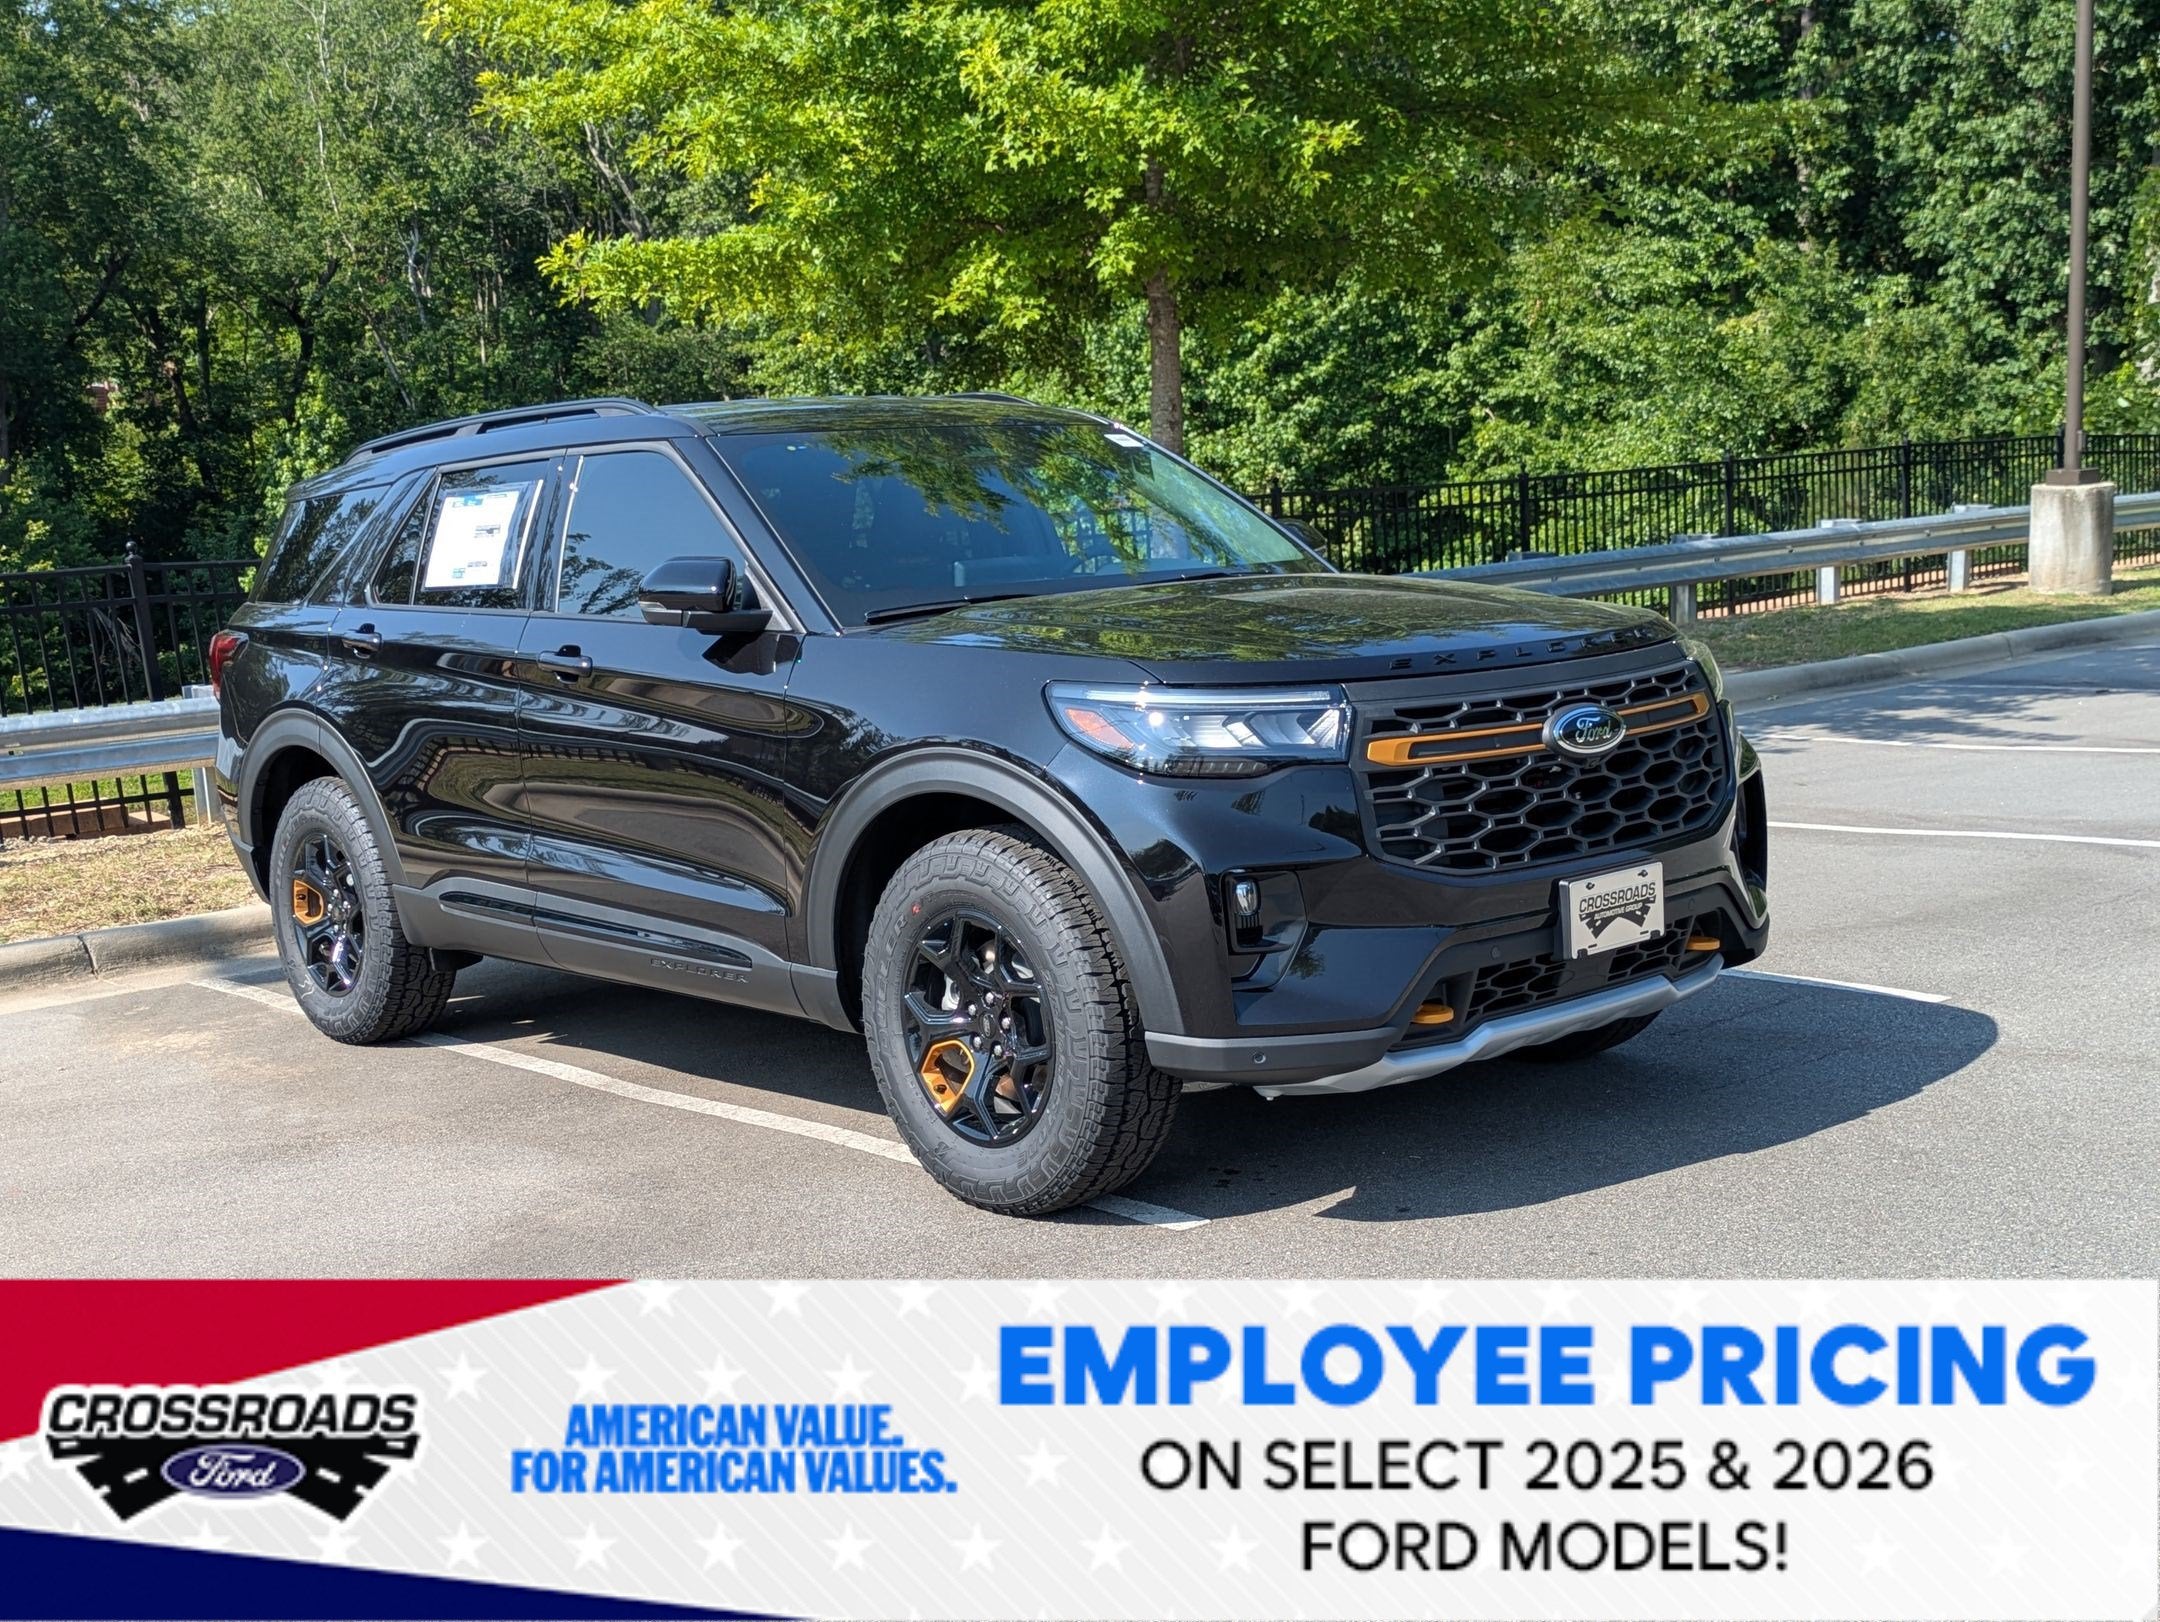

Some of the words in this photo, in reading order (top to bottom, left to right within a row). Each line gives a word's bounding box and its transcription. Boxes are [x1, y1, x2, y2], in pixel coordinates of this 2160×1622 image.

[1575, 716, 1613, 743] Ford
[1579, 882, 1656, 913] CROSSROADS
[651, 958, 749, 983] EXPLORER
